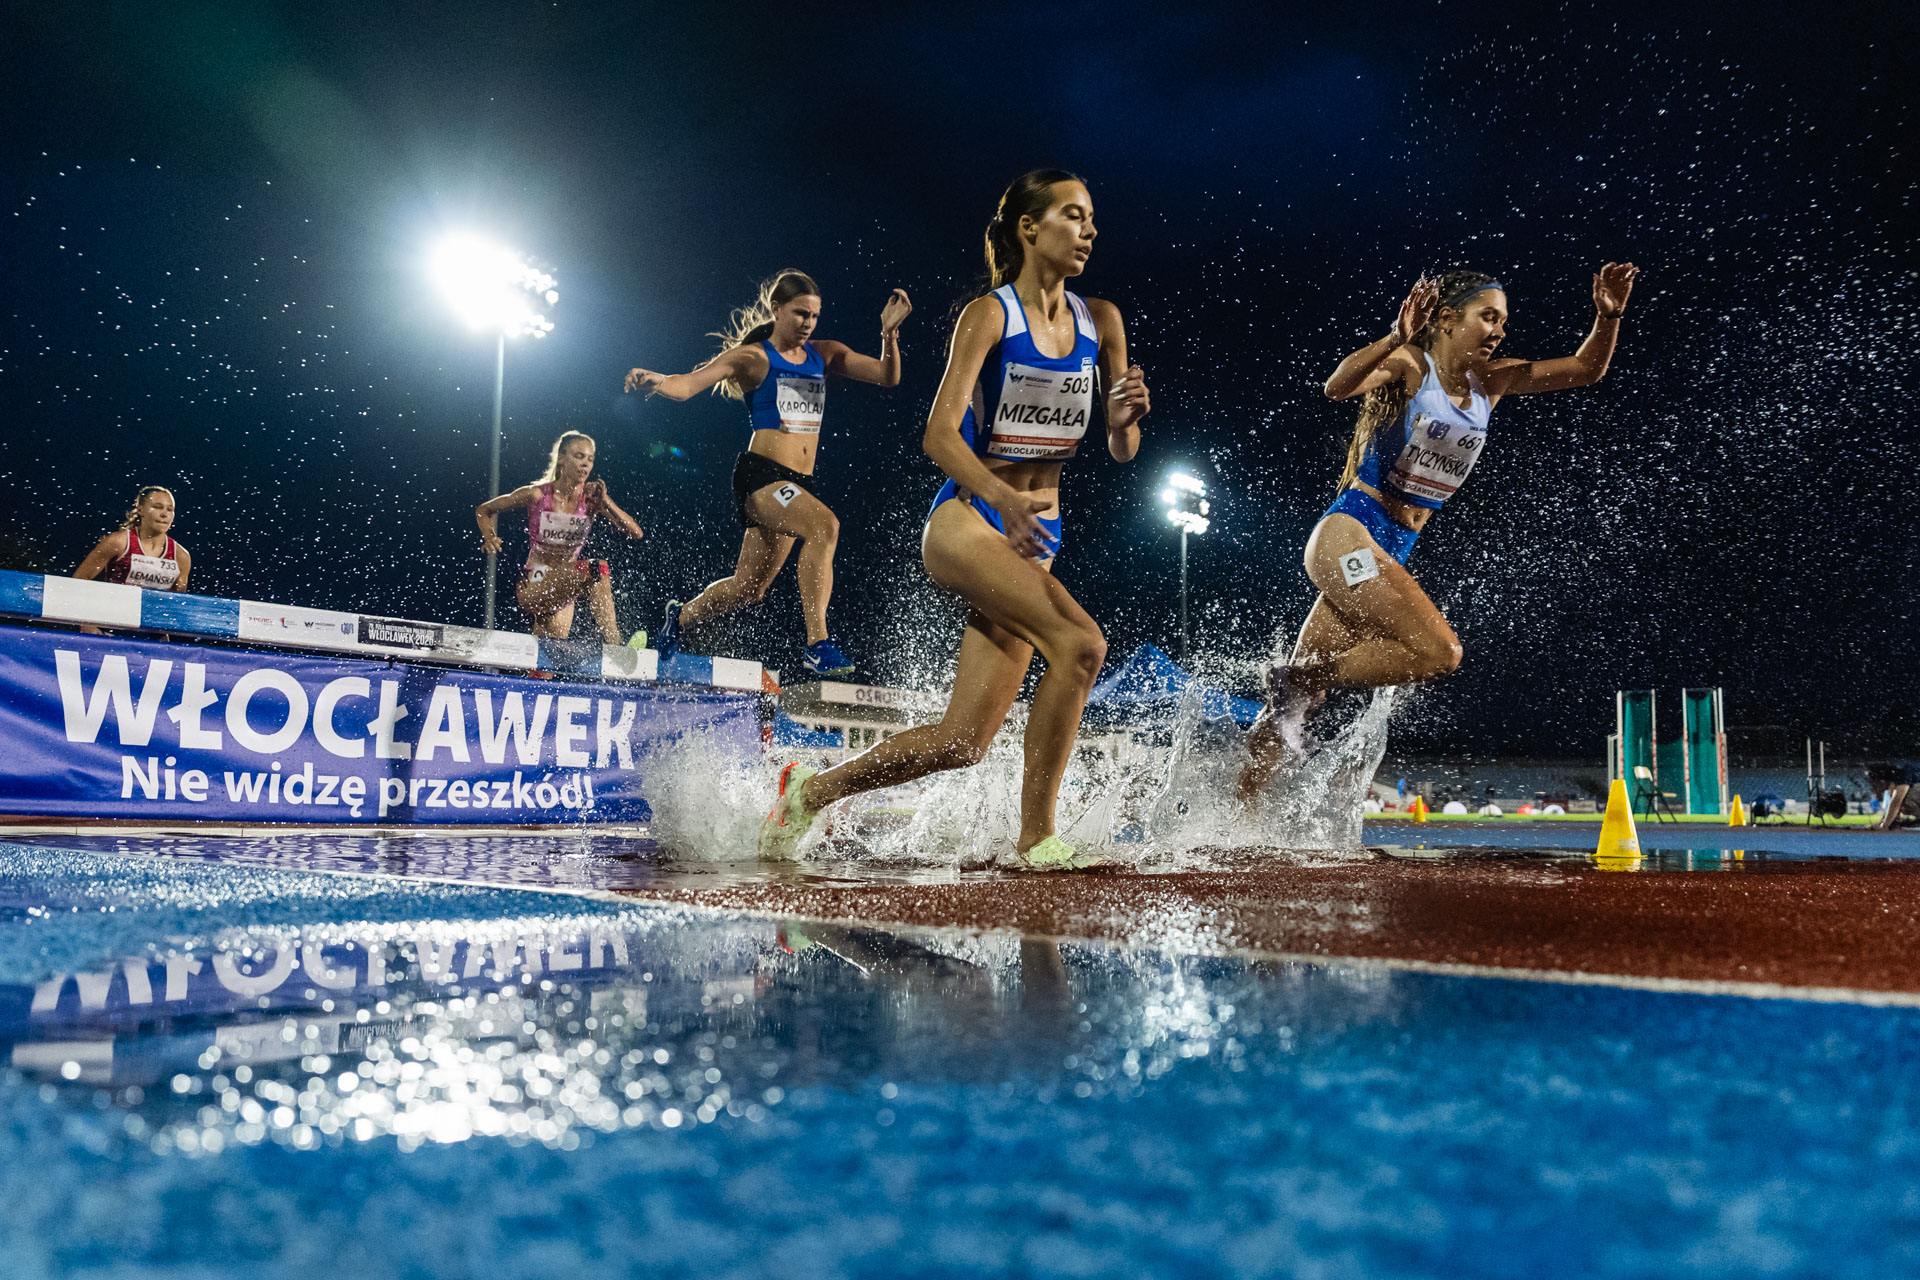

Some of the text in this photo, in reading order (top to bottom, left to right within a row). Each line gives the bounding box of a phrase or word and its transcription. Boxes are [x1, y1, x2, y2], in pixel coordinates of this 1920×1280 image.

[1060, 377, 1089, 394] 503
[999, 403, 1085, 427] MIZGAŁA
[1000, 446, 1053, 456] WŁOCŁAWEK
[1457, 434, 1482, 451] 667
[1405, 445, 1470, 478] TYCZYŃSKA
[780, 486, 795, 501] 5
[160, 561, 177, 570] 733
[1347, 558, 1363, 578] 9
[130, 570, 175, 585] LEMAŃSKA
[369, 629, 415, 644] WŁOCŁAWEK
[54, 649, 637, 769] WŁOCŁAWEK
[121, 756, 595, 817] Nie widzę przeszkód!
